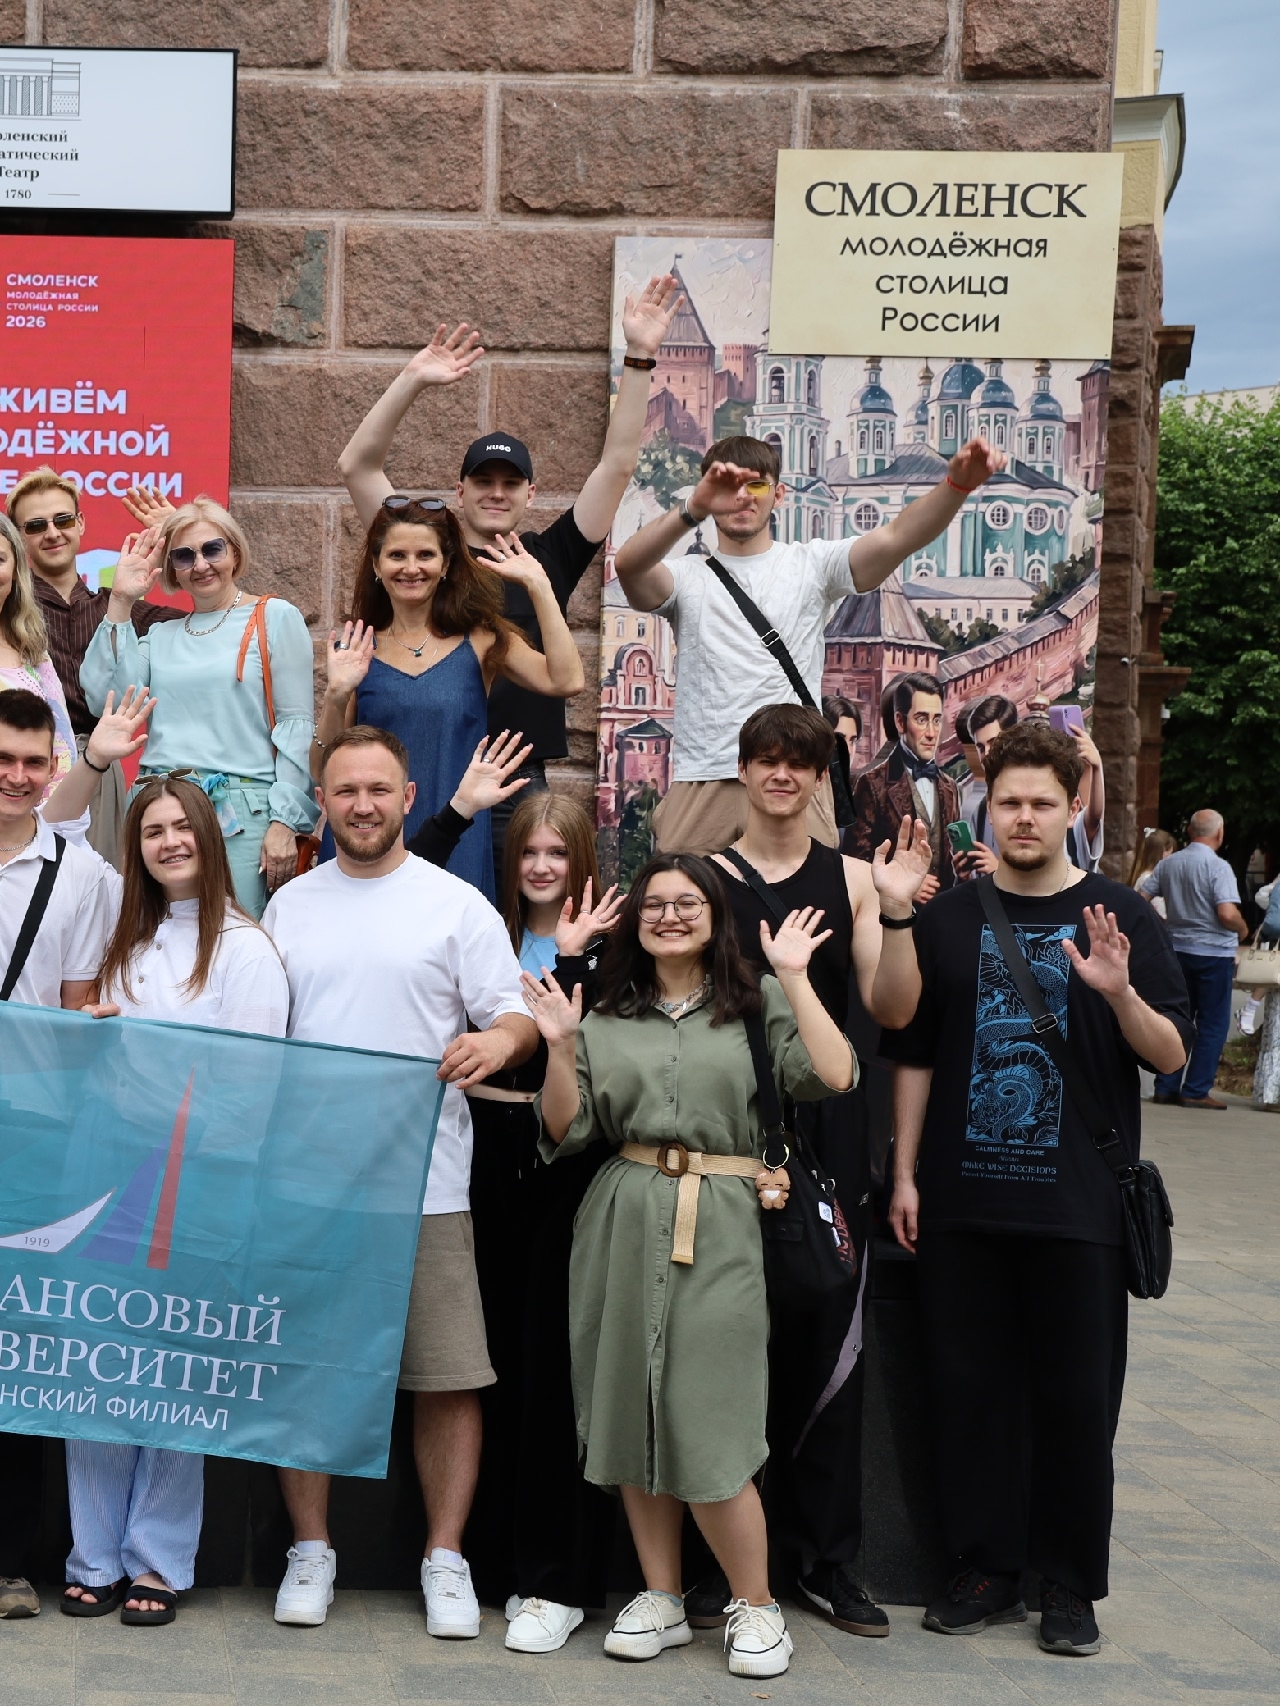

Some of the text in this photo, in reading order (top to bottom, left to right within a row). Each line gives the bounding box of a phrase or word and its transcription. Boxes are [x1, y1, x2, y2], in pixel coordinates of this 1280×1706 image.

[5, 189, 32, 199] 1780
[805, 180, 1087, 218] СМОЛЕНСК
[839, 231, 1048, 259] молодёжная
[6, 273, 99, 287] СМОЛЕНСК
[875, 274, 1009, 297] столица
[6, 290, 79, 300] МОЛОДЁЖНАЯ
[6, 302, 99, 313] СТОЛИЦА РОССИИ
[6, 314, 47, 328] 2026
[881, 306, 1000, 333] России
[486, 444, 512, 453] HUGO
[56, 470, 183, 499] ОССИИ
[24, 1236, 50, 1247] 1919
[106, 1396, 228, 1431] ФИЛИАЛ
